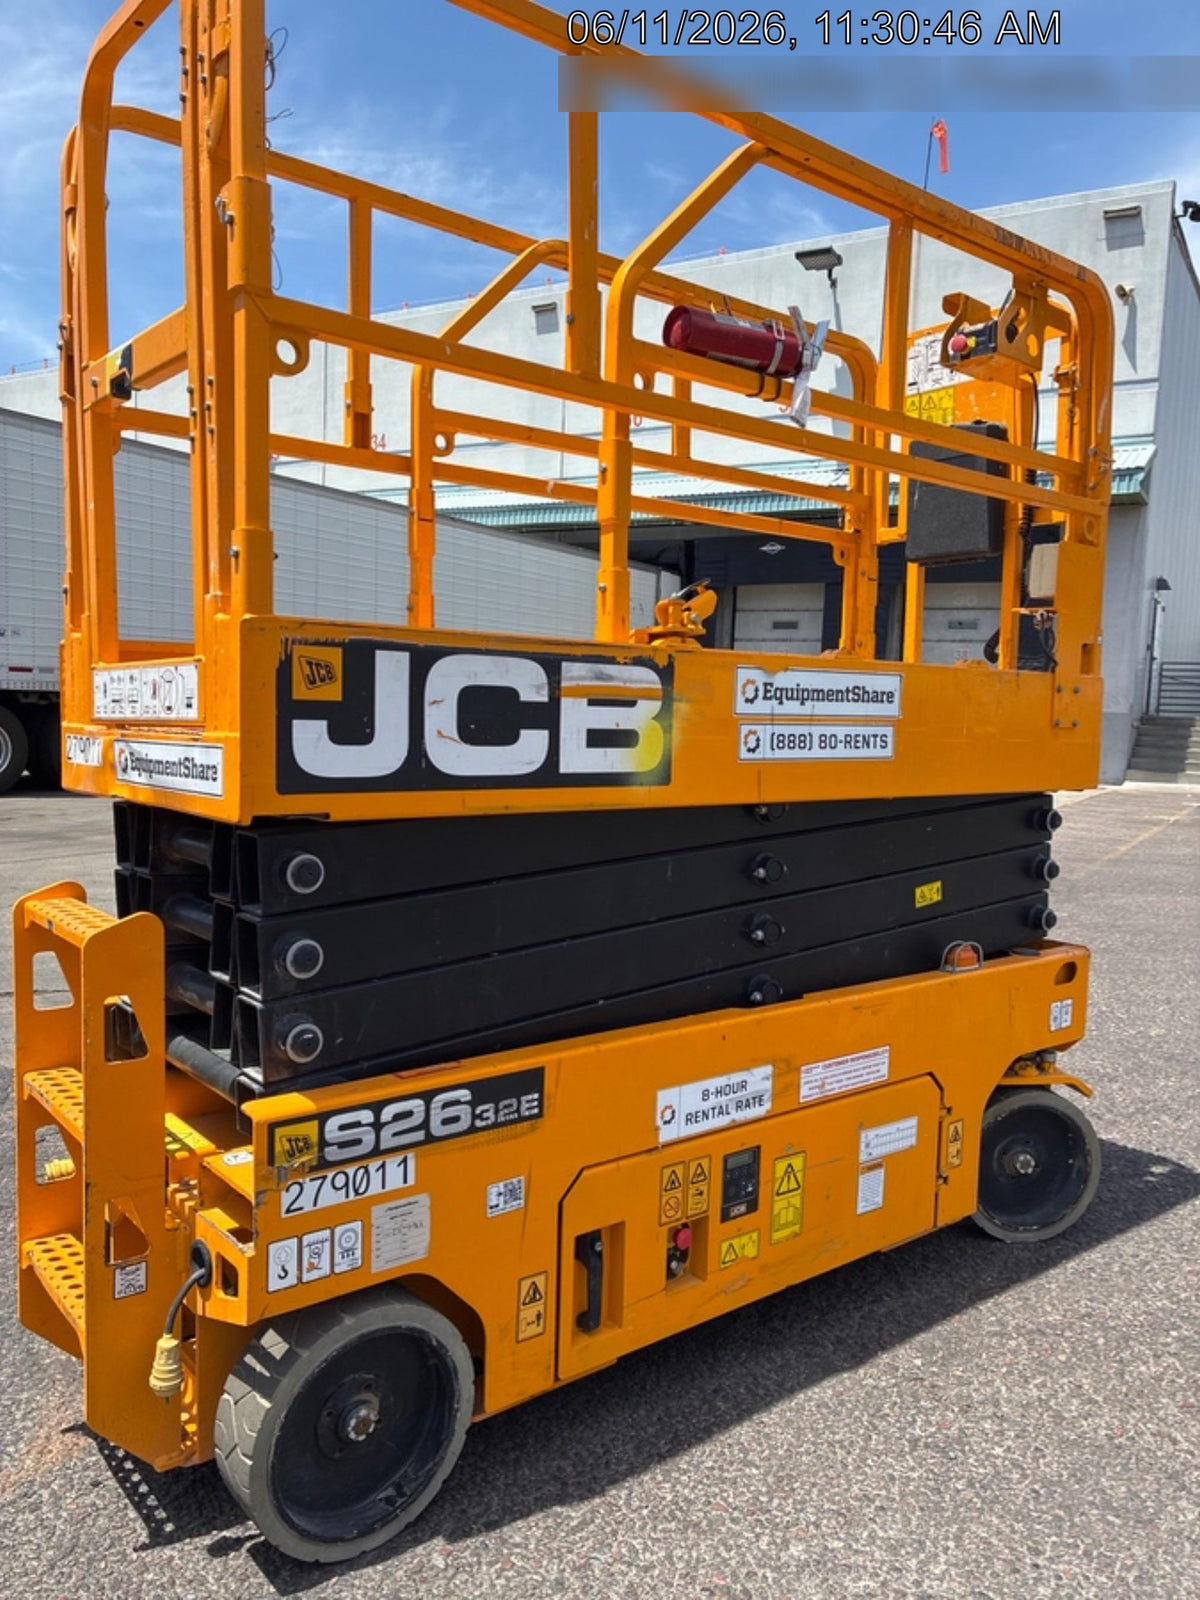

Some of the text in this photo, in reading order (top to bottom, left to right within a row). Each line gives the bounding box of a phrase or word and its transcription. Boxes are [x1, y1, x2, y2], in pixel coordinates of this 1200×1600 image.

[306, 660, 334, 685] JCB
[762, 682, 895, 706] EquipmentShare
[291, 649, 664, 778] JCB
[770, 732, 889, 751] (888) 80-RENTS
[130, 751, 218, 783] EquipmentShare
[701, 1080, 748, 1102] 8-HOUR
[685, 1095, 765, 1126] RENTAL RATE
[284, 1155, 409, 1215] 279011
